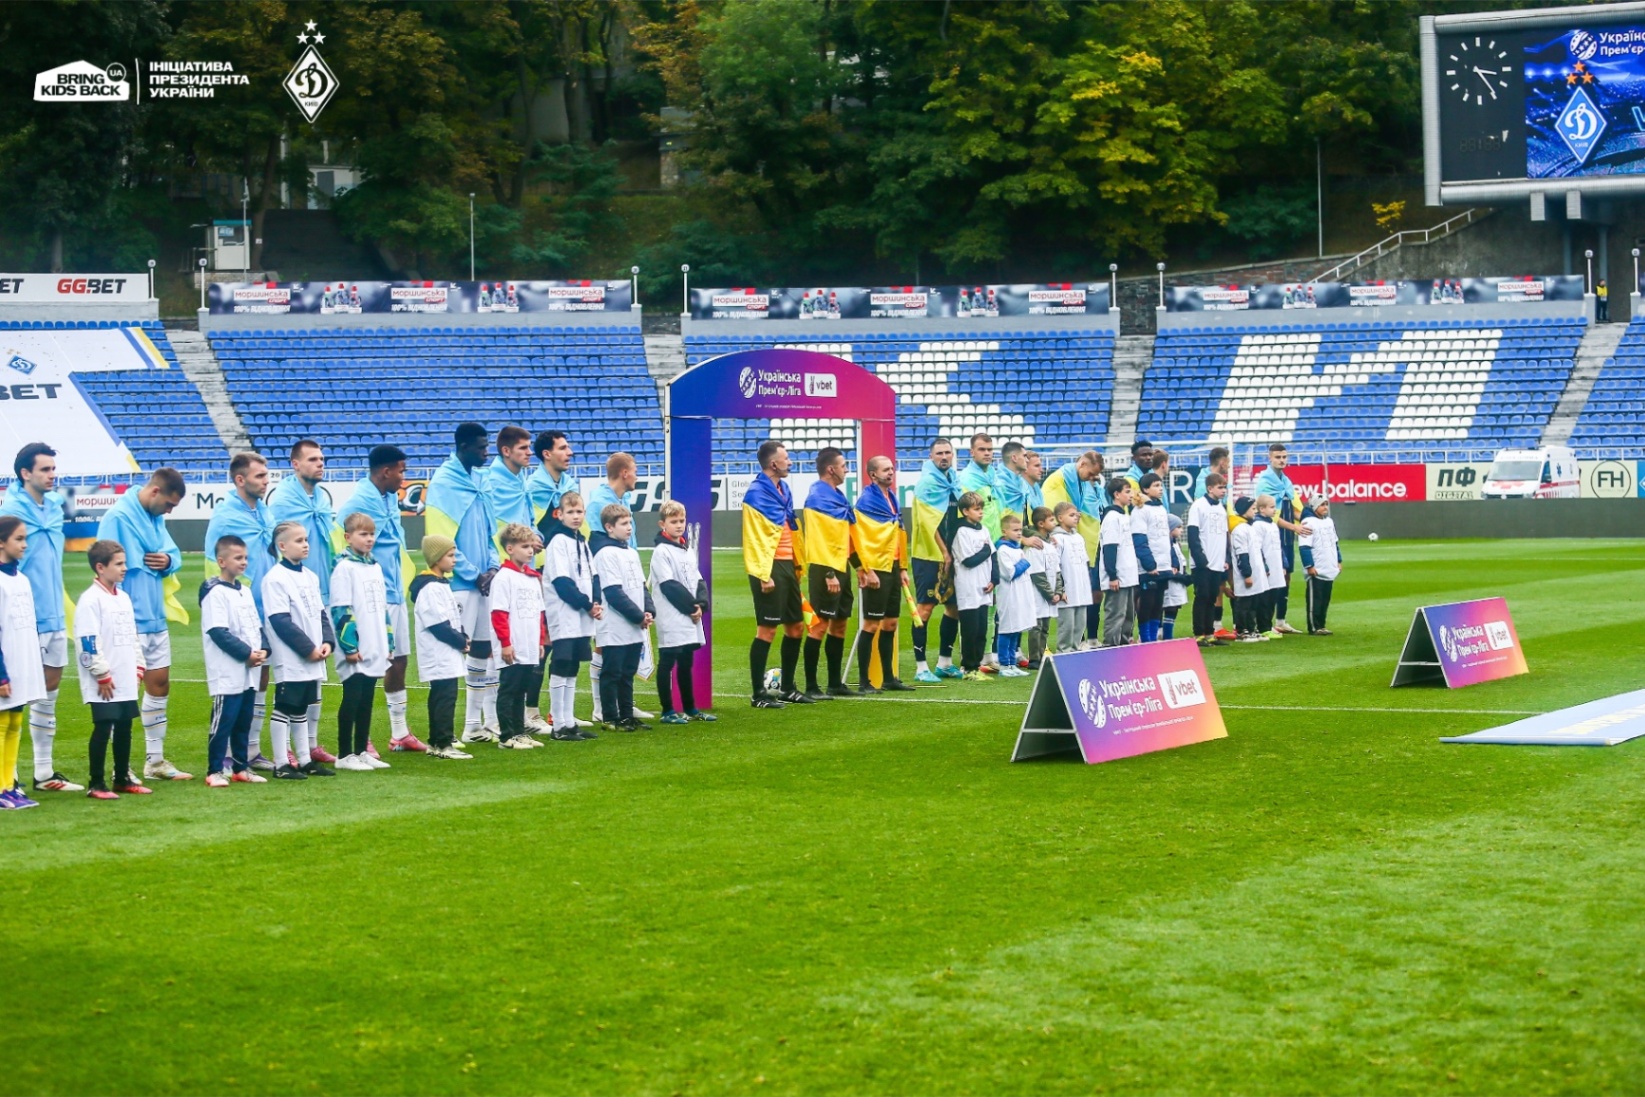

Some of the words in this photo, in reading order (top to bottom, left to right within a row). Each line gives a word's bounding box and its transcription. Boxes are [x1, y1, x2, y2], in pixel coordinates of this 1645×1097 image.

[1600, 43, 1645, 57] Прем'єр-
[57, 278, 127, 294] GG.BET
[550, 288, 603, 296] моршинська
[714, 296, 767, 304] моршинська
[872, 295, 925, 303] моршинська
[1030, 291, 1083, 299] моршинська
[758, 369, 801, 384] Українська
[816, 380, 832, 390] vbet
[1437, 467, 1476, 487] ПФ
[1598, 471, 1624, 488] FH
[1292, 483, 1319, 498] ew
[1322, 479, 1407, 498] balance
[1435, 491, 1474, 500] DIGITAL
[76, 498, 118, 507] моршин
[1099, 676, 1156, 700] Українська
[1175, 679, 1197, 696] vbet
[1108, 696, 1163, 721] Прем'єр-Ліга
